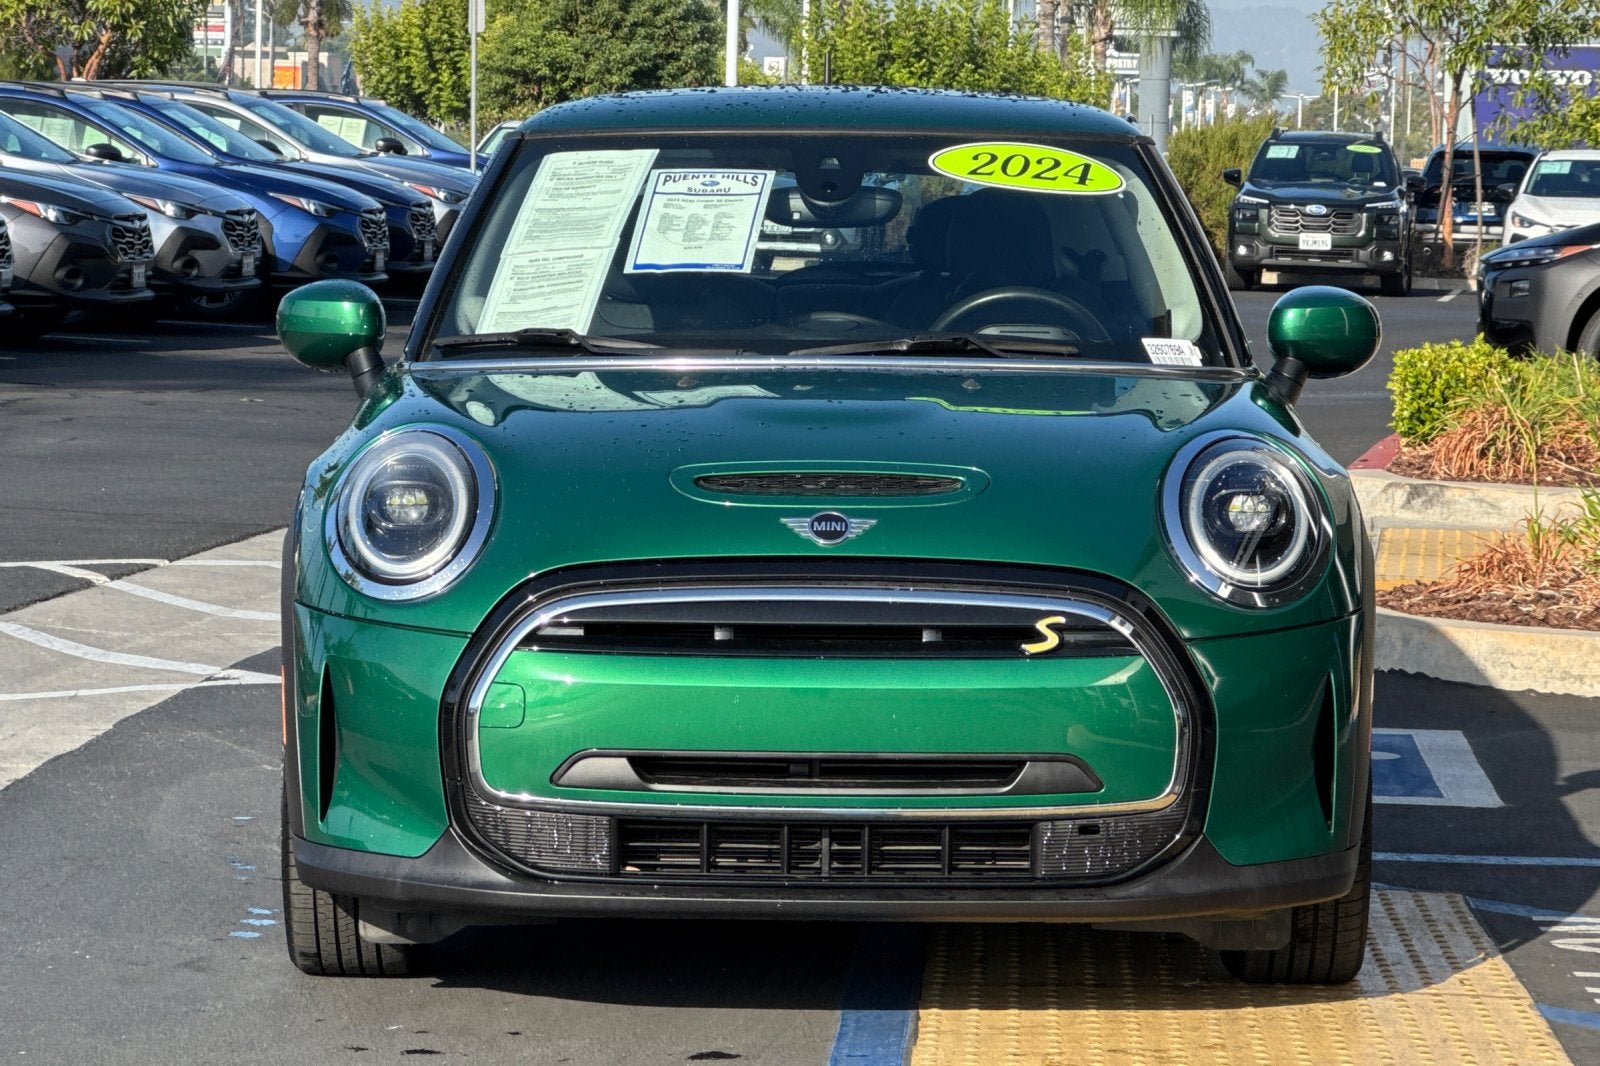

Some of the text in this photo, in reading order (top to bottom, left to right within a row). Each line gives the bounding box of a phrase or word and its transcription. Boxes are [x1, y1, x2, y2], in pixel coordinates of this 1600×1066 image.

[662, 172, 759, 187] PUENTE HILLS
[967, 152, 1094, 186] 2024
[813, 521, 846, 531] MINI
[1021, 615, 1066, 655] S
